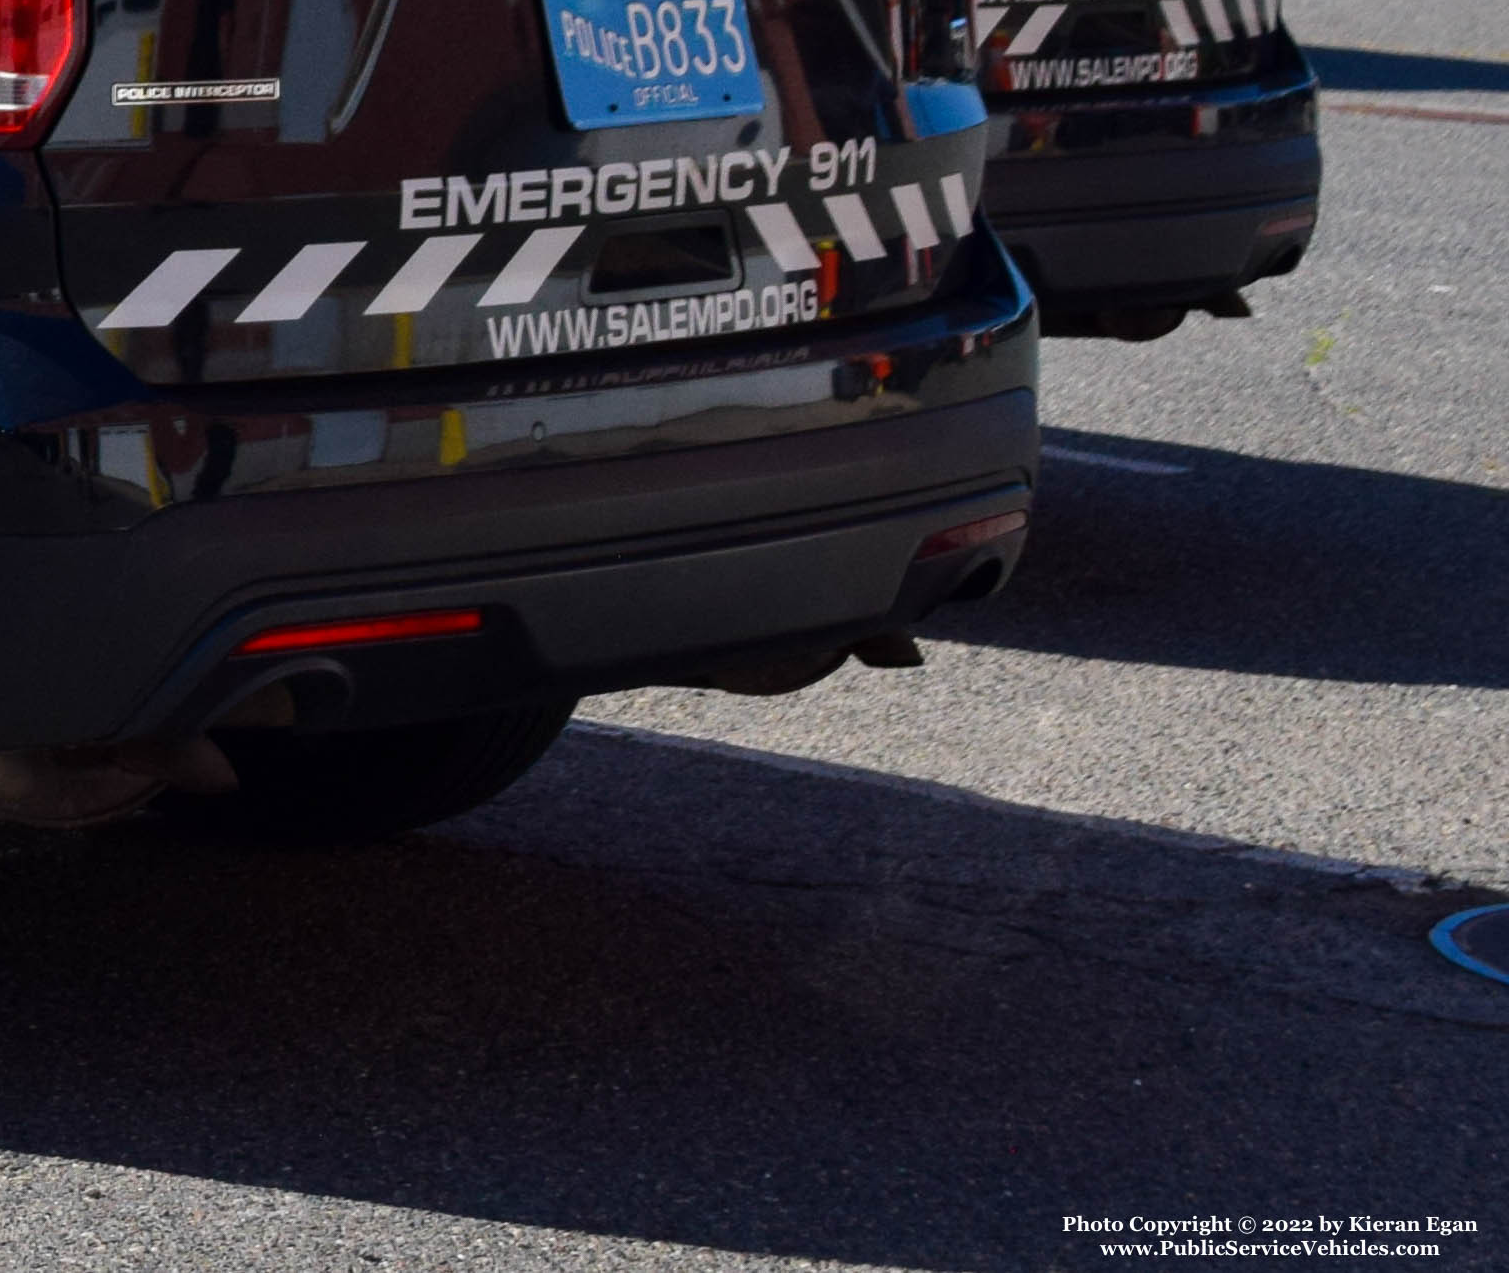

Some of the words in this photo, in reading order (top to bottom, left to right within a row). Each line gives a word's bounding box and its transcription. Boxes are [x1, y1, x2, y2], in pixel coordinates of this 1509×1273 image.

[561, 10, 637, 77] POLICE
[117, 86, 172, 101] POLICE
[174, 83, 275, 99] INTERCEPTOR
[633, 83, 700, 107] OFFICIAL
[399, 146, 792, 229] EMERGENCY
[809, 136, 877, 191] 911
[487, 279, 818, 360] WWW.SALEMPD.ORG
